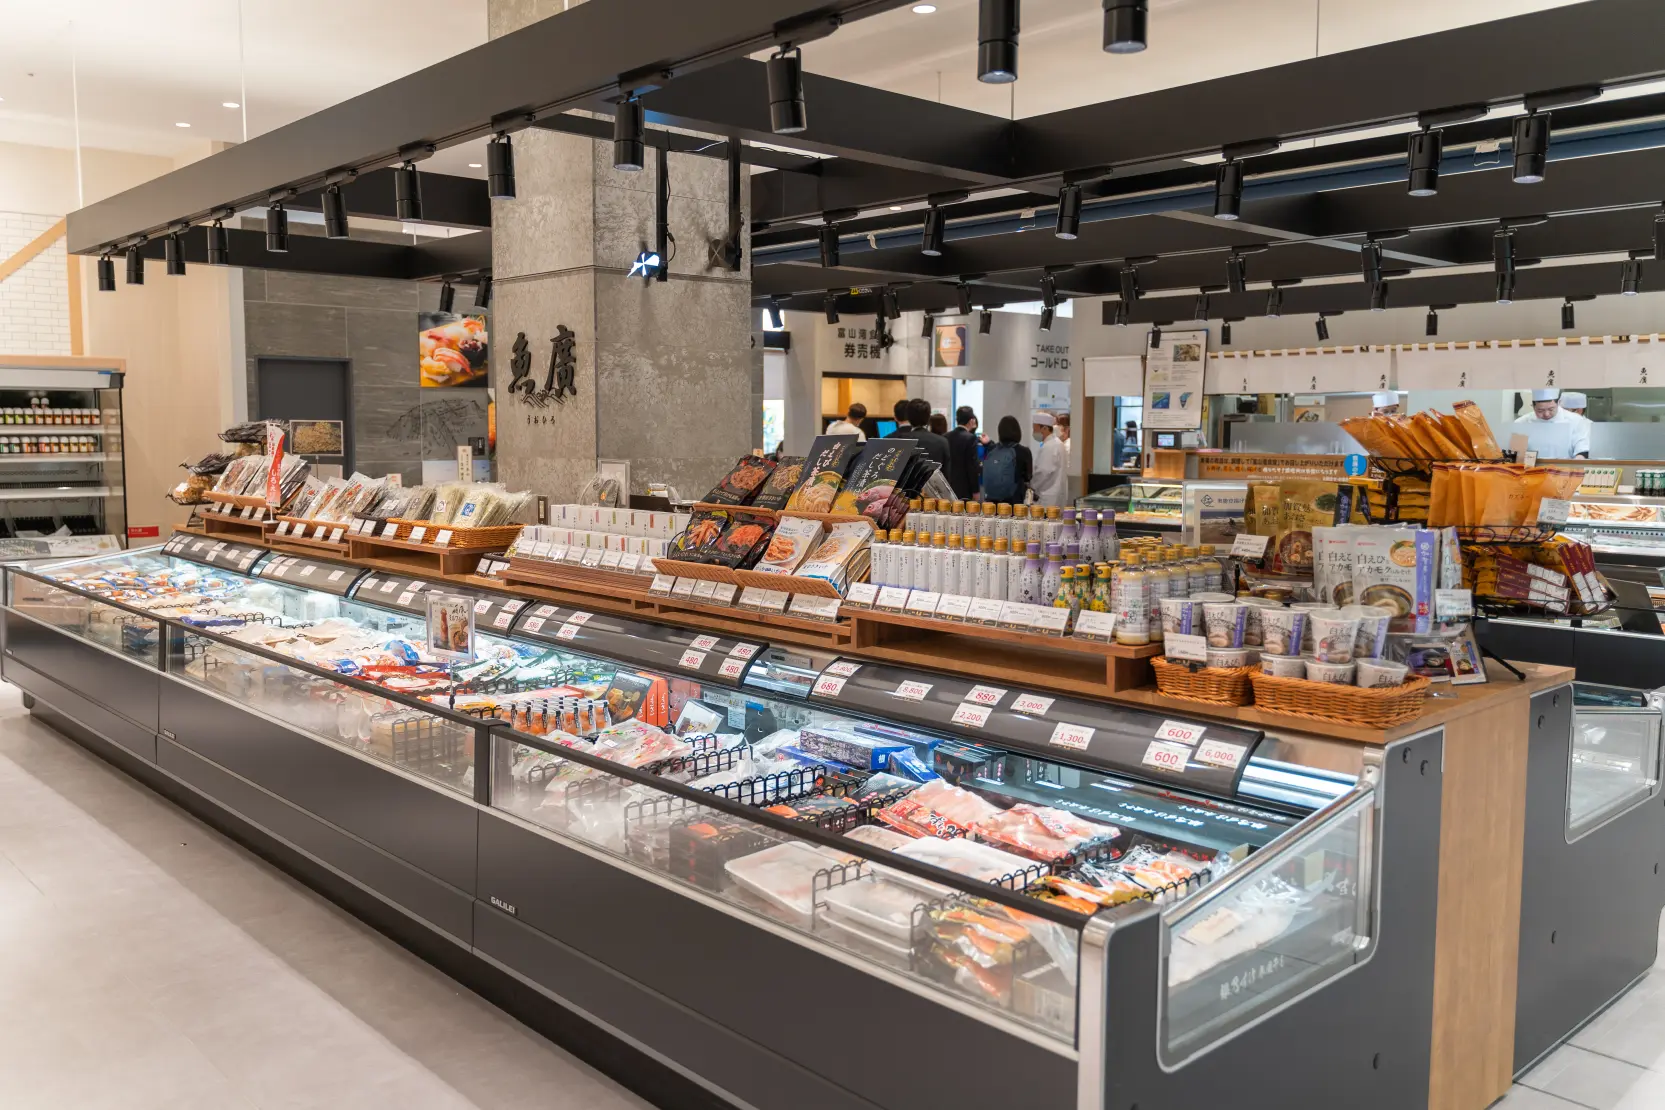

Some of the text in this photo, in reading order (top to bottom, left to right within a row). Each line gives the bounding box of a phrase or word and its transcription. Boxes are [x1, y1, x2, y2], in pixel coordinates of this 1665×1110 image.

[837, 328, 879, 340] 富山湾食
[844, 343, 881, 359] 券売機
[1036, 344, 1069, 354] TAKE OUT
[1031, 357, 1071, 369] コールドロ
[526, 414, 556, 425] うおひろ
[737, 647, 752, 656] 480
[684, 656, 698, 665] 480
[725, 664, 739, 674] 480
[820, 682, 838, 692] 680
[975, 691, 996, 702] 880
[1020, 700, 1043, 710] 3,000
[960, 711, 982, 722] 2,200
[1058, 732, 1084, 744] 1,300
[1167, 728, 1192, 740] 600
[1154, 752, 1179, 765] 600
[1204, 750, 1235, 761] 6,000
[490, 896, 515, 914] GALILEI
